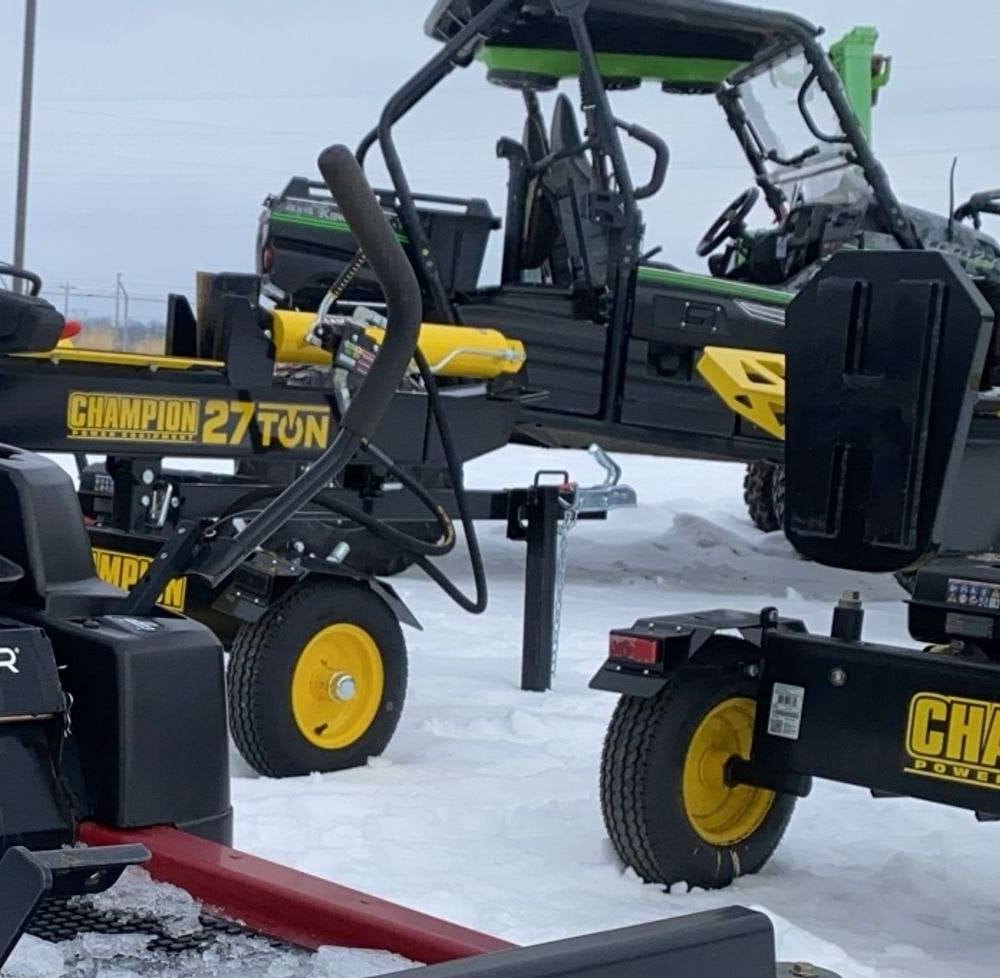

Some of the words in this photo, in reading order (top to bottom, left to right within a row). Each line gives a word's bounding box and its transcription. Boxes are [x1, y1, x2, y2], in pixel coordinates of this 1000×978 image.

[71, 394, 196, 433] CHAMPION
[202, 400, 255, 445] 27
[257, 406, 330, 449] TON
